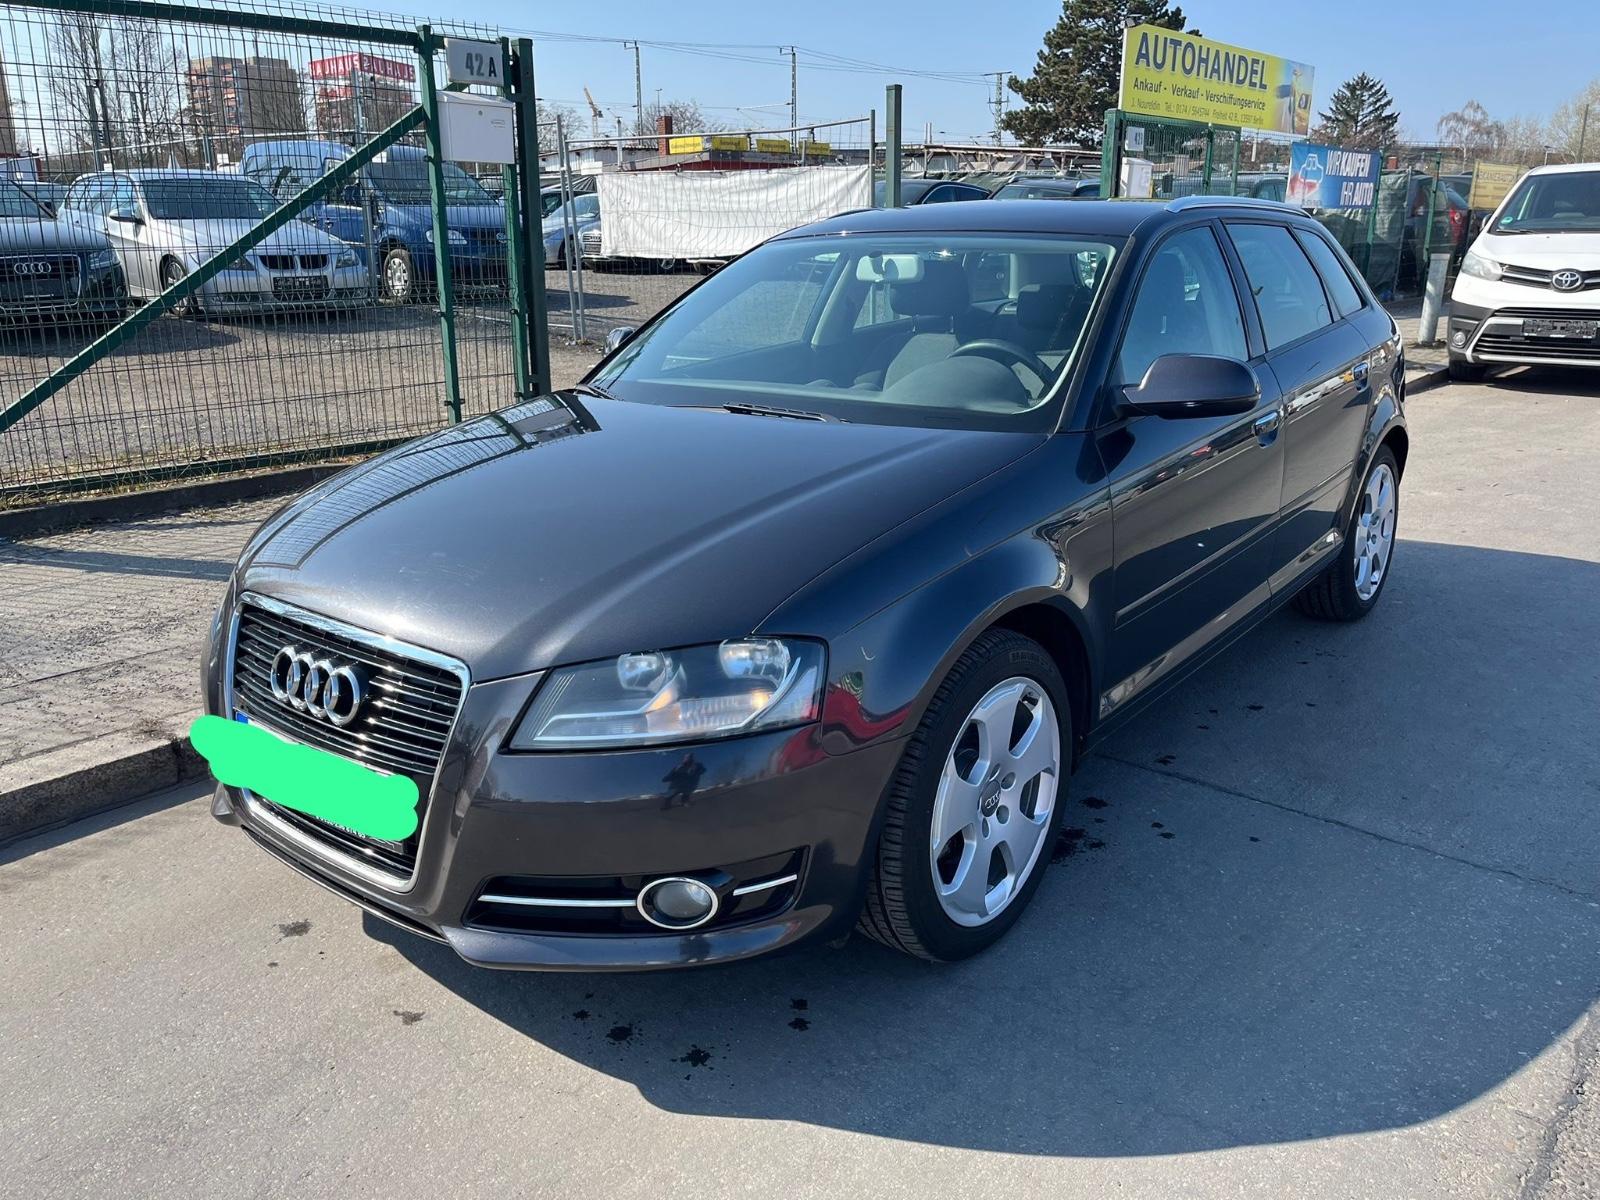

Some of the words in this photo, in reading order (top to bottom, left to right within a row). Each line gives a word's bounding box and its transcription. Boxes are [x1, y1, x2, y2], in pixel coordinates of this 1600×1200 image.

[465, 52, 485, 76] 42
[488, 56, 497, 78] A
[1135, 32, 1267, 90] AUTOHANDEL
[1133, 77, 1163, 93] Ankauf
[1171, 84, 1200, 99] Verkauf
[1205, 90, 1266, 110] Verschiffungservice
[1325, 150, 1341, 176] WIR
[1340, 151, 1371, 177] KAUFEN
[1340, 181, 1354, 206] IHR
[1352, 182, 1374, 206] AUTO
